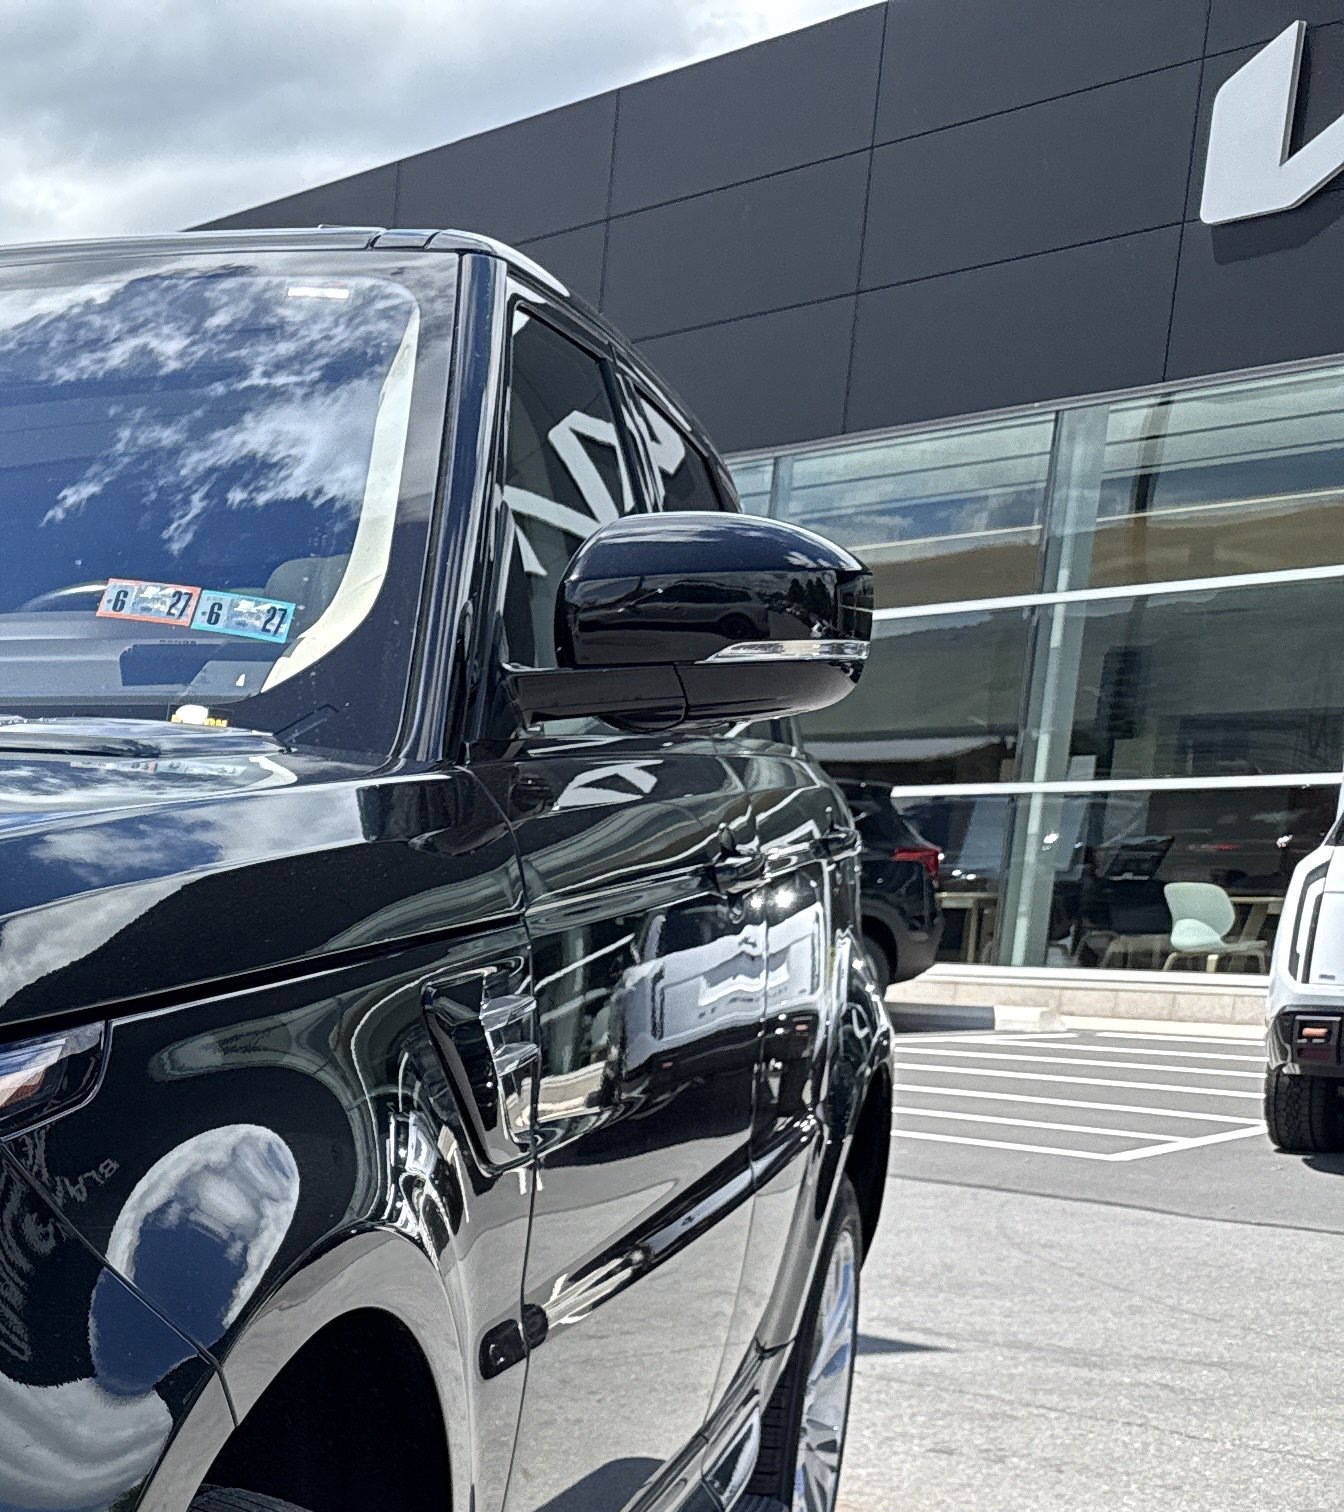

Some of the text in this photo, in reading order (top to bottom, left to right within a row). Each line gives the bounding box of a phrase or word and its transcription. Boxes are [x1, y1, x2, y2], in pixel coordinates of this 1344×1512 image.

[112, 590, 194, 620] 6 27
[206, 602, 288, 636] 6 27
